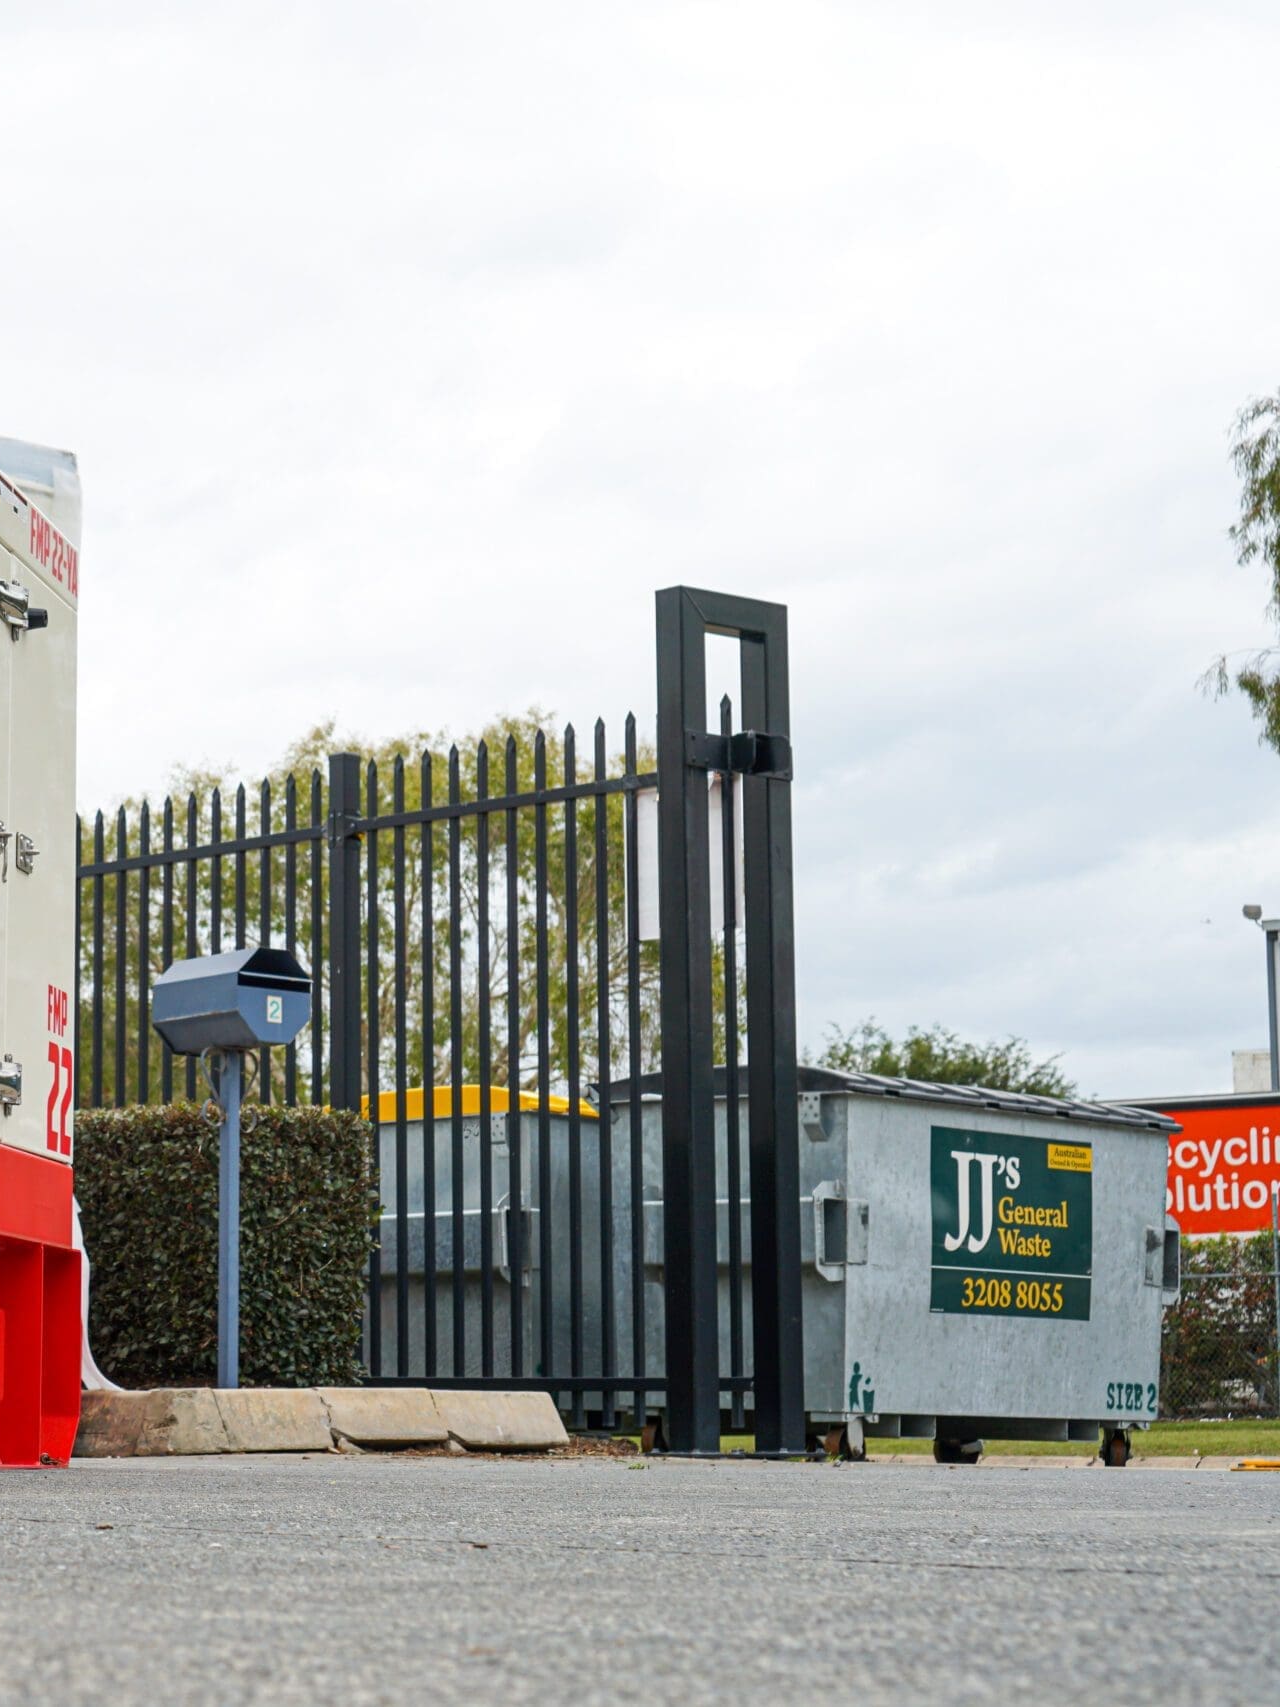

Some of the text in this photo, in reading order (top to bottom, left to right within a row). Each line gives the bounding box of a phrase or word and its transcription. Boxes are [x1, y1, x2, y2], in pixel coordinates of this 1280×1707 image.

[30, 507, 51, 568] FMP
[48, 984, 68, 1038] FMP
[270, 1000, 281, 1020] 2
[47, 1041, 73, 1157] 22
[1055, 1147, 1087, 1159] Australian
[1168, 1126, 1280, 1178] cycli
[997, 1196, 1069, 1229] General
[997, 1227, 1052, 1258] Waste
[961, 1277, 1064, 1312] 3208 8055
[1106, 1382, 1157, 1413] SIZE 2
